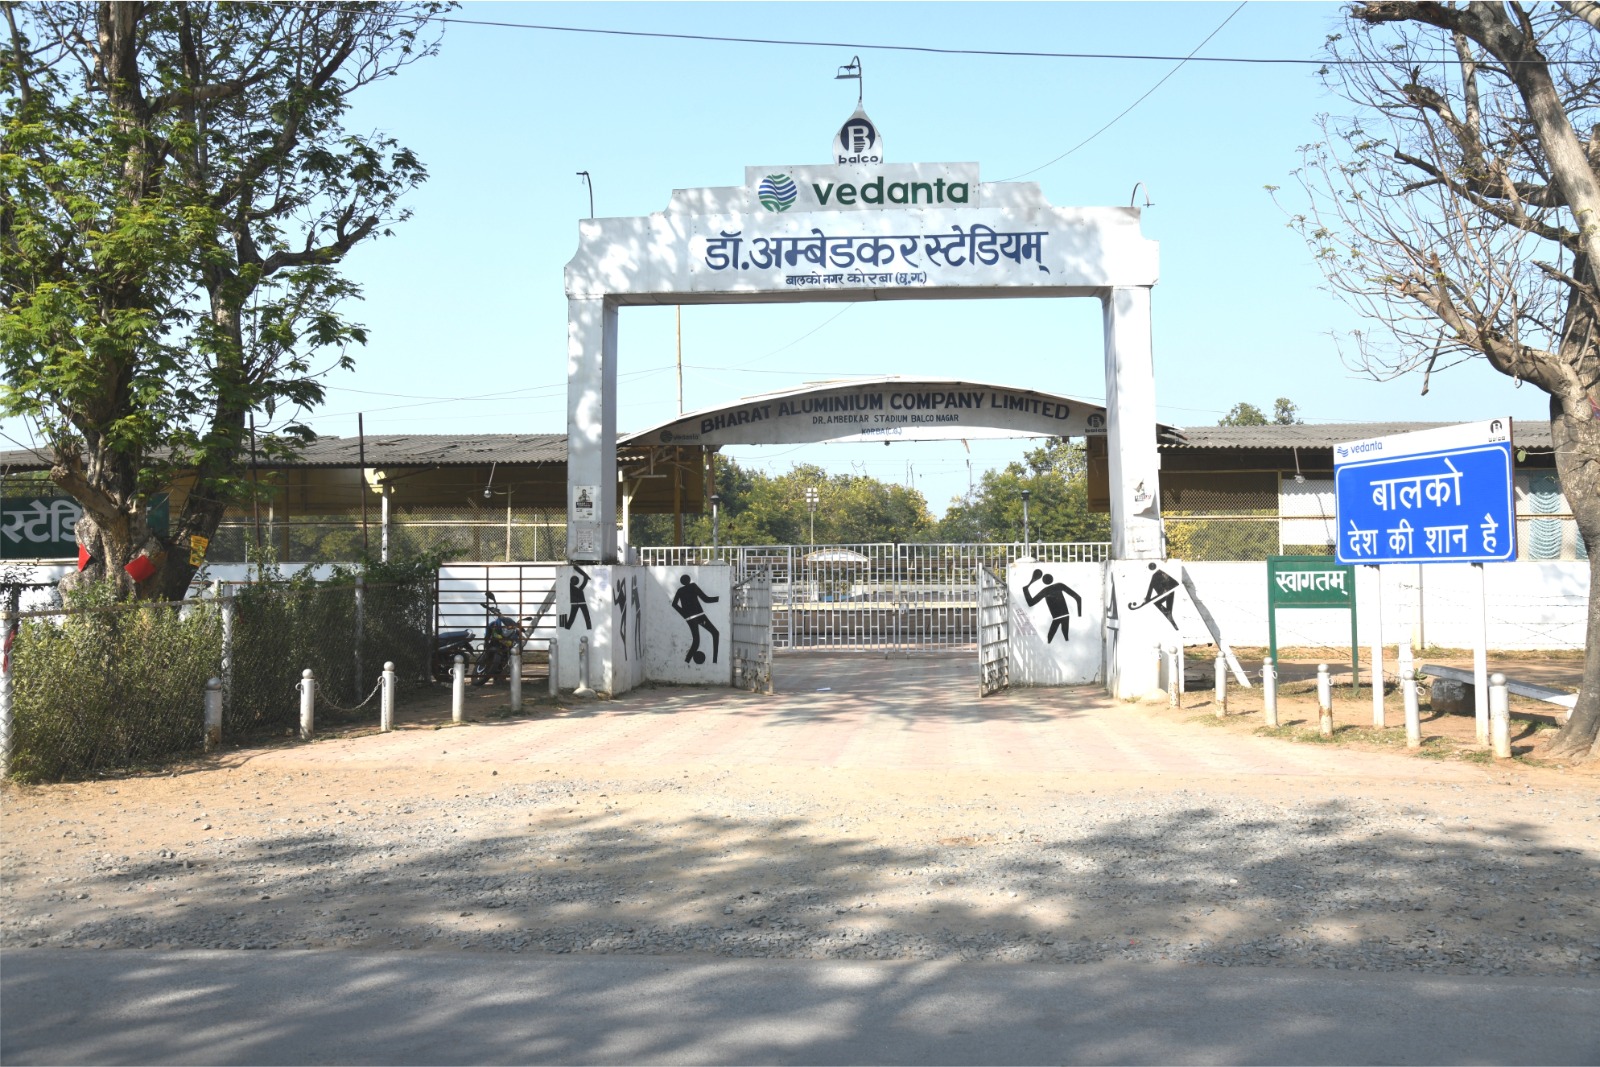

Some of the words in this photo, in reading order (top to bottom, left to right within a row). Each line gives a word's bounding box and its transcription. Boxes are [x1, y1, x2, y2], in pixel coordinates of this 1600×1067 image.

[838, 154, 879, 164] balco
[812, 176, 969, 205] vedanta
[923, 223, 1051, 275] स्टेडियम्
[785, 271, 822, 286] बालको
[823, 273, 844, 285] नगर
[847, 268, 893, 285] कोरबा
[701, 404, 772, 434] BHARAT
[778, 393, 883, 417] ALUMINIUM
[890, 391, 985, 410] COMPANY
[991, 393, 1071, 420] LIMITED
[874, 414, 908, 423] STADIUM
[911, 414, 934, 423] BALCO
[936, 413, 960, 422] NAGAR
[1350, 440, 1383, 453] vedanta
[1369, 457, 1463, 511] बालको
[0, 499, 83, 544] स्टेडि
[1347, 519, 1379, 557] देश
[1386, 518, 1414, 555] की
[1424, 524, 1469, 555] शान
[1480, 513, 1499, 553] है
[1275, 570, 1348, 595] स्वागतम्
